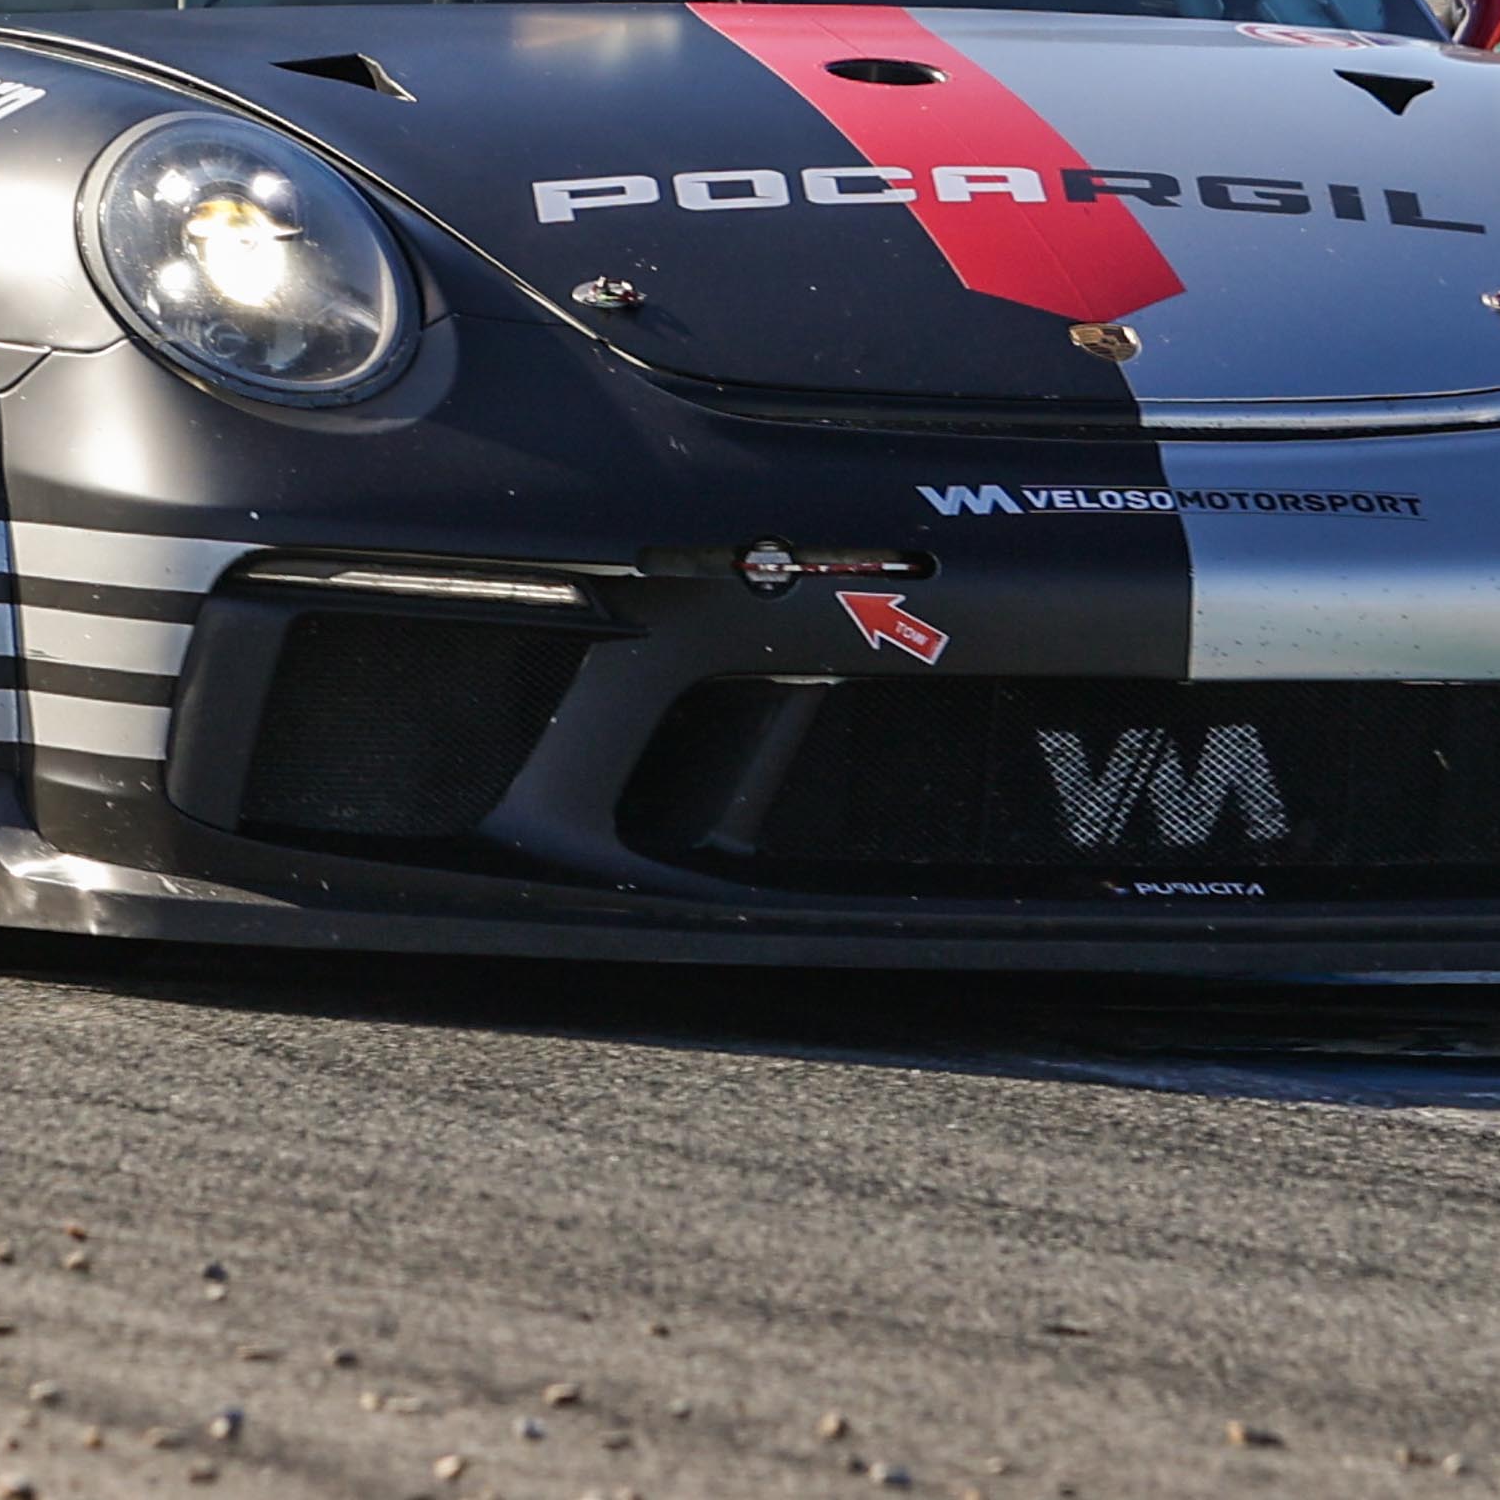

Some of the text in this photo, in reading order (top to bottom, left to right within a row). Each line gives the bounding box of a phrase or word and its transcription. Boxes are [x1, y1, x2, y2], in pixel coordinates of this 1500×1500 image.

[531, 166, 1488, 234] POCARGIL
[894, 620, 930, 647] TOW
[1035, 721, 1293, 848] VM
